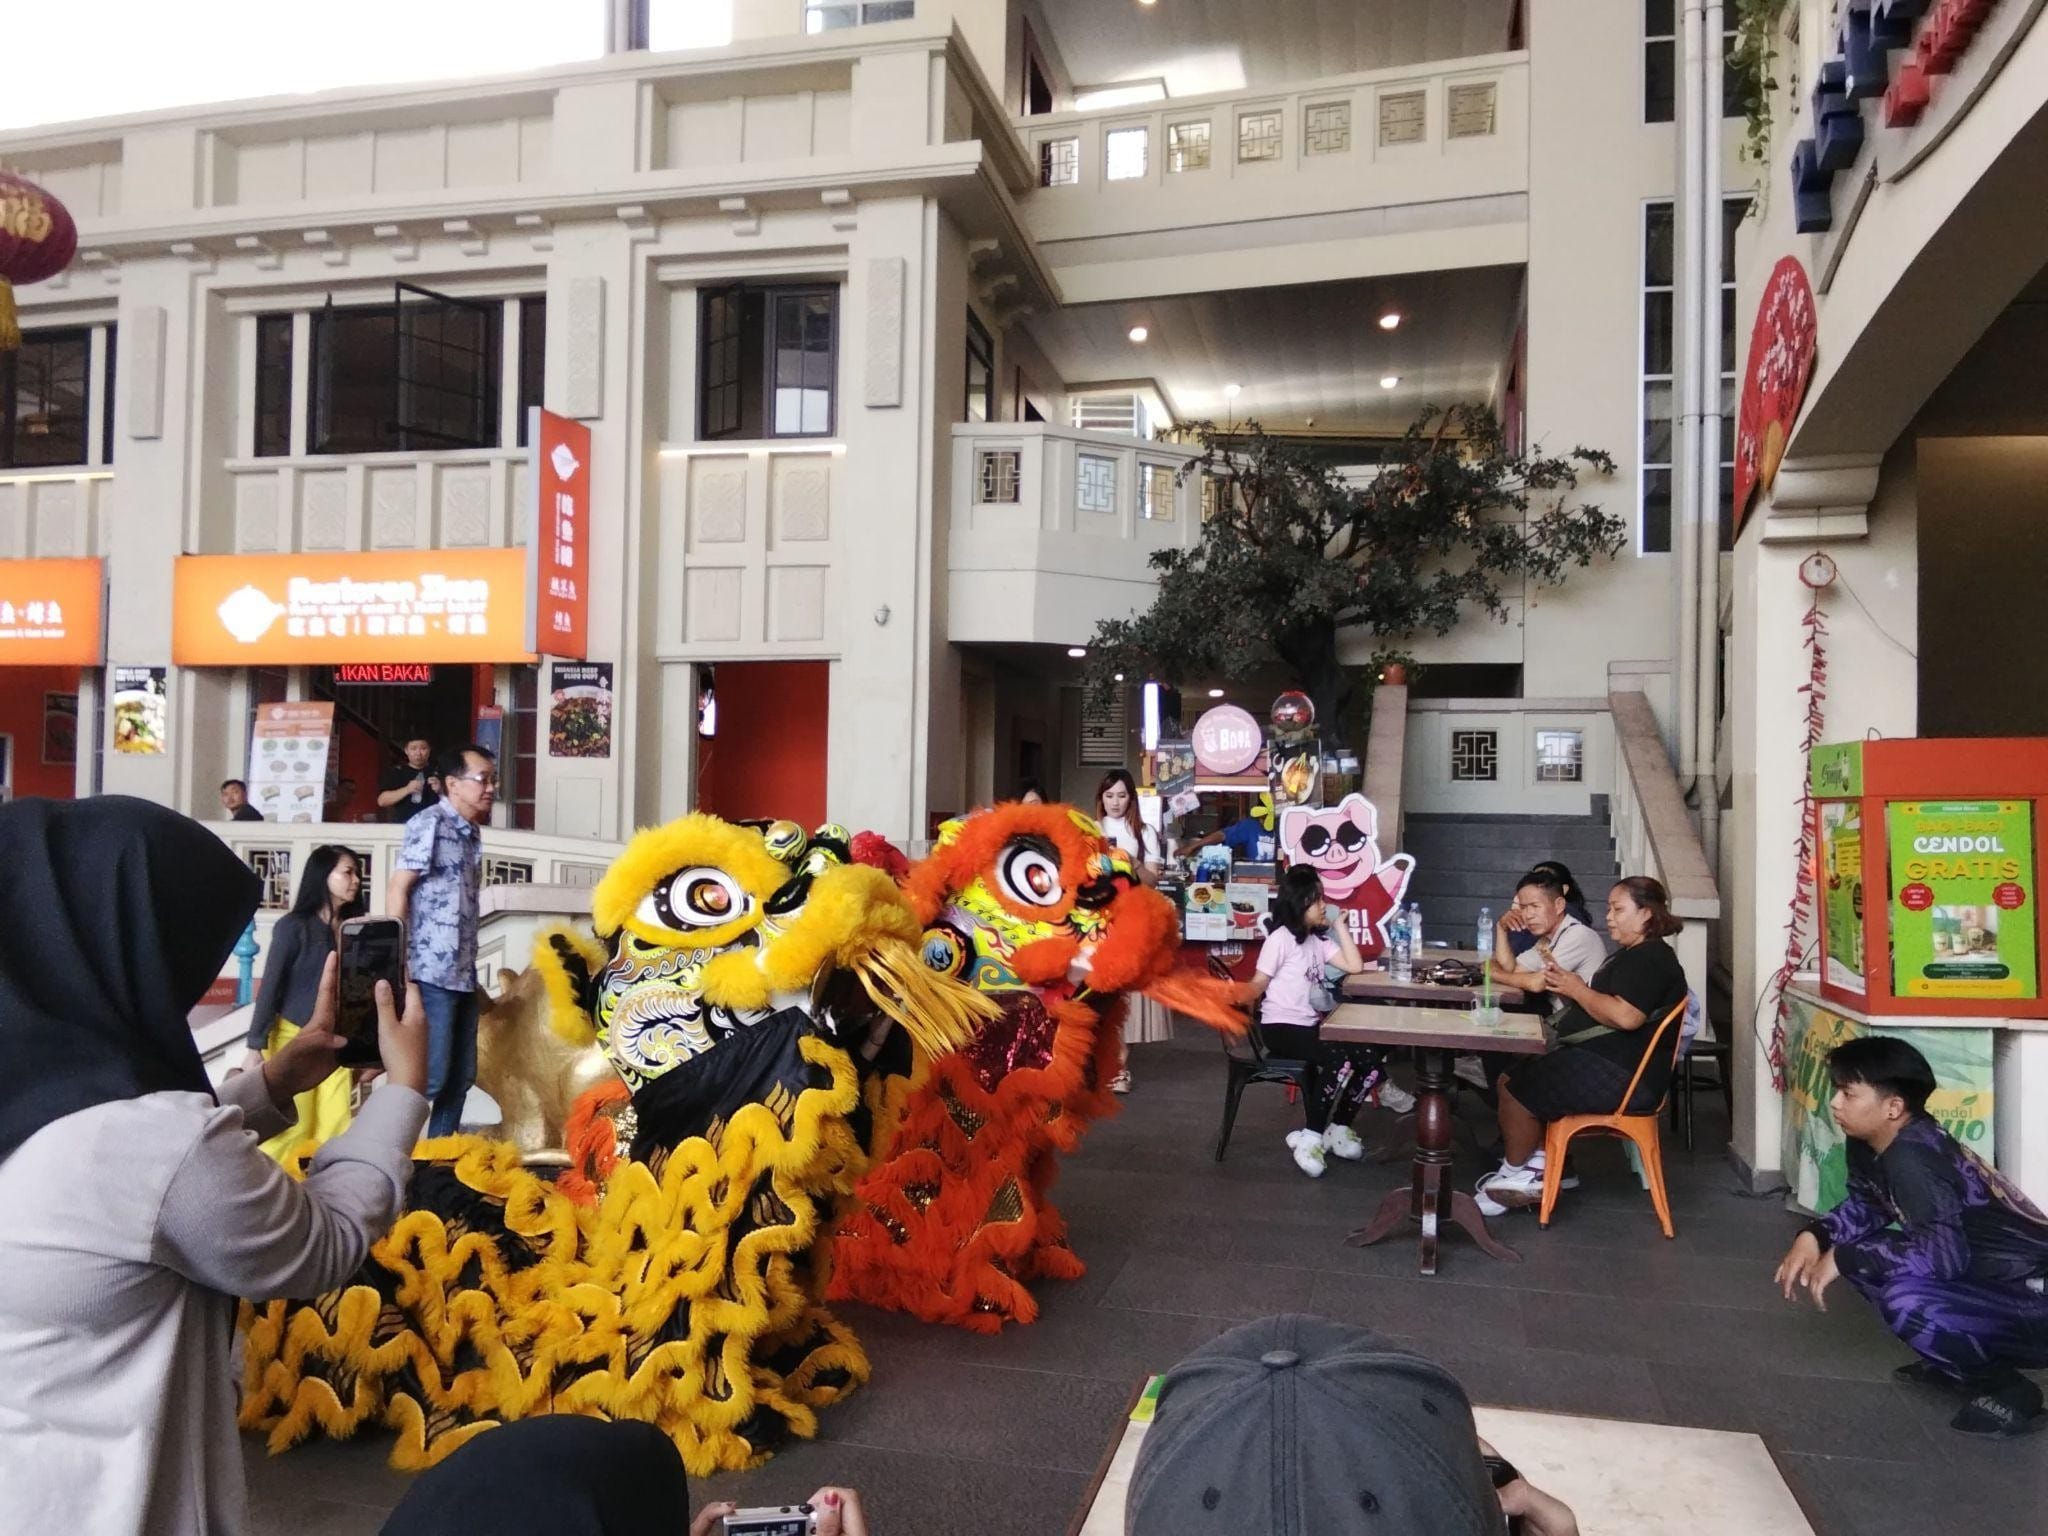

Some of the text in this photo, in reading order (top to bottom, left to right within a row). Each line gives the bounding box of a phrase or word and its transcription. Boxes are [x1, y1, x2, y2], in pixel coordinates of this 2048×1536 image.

[342, 665, 378, 681] IKAN
[1913, 836, 2005, 854] CENDOL
[1905, 858, 2020, 880] GRATIS
[1349, 909, 1368, 927] BI
[1349, 927, 1374, 945] TA
[1932, 1106, 1973, 1119] endol
